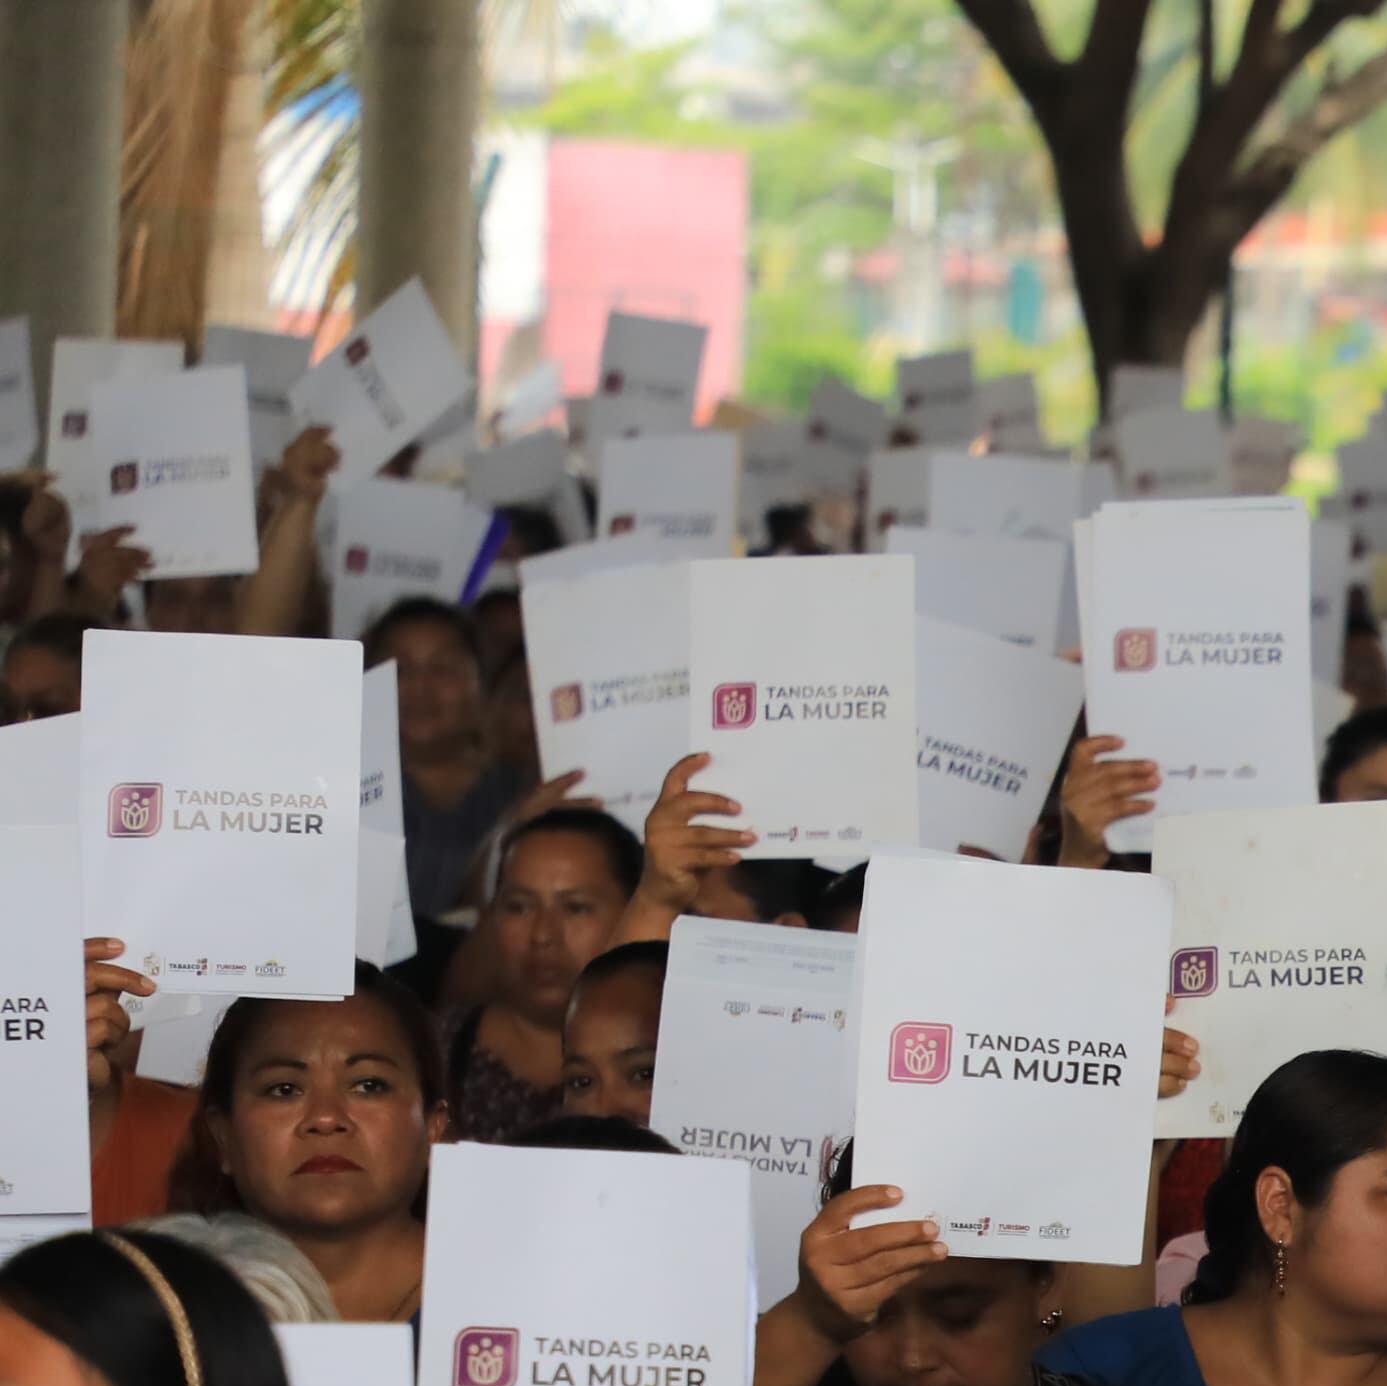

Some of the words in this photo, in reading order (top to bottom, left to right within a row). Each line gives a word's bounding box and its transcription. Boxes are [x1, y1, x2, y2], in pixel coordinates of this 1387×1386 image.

[1168, 632, 1234, 645] TANDAS
[1240, 632, 1284, 645] PARA
[1165, 648, 1195, 665] LA
[1201, 647, 1283, 665] MUJER
[766, 685, 838, 698] TANDAS
[843, 685, 890, 698] PARA
[764, 702, 795, 720] LA
[803, 701, 887, 720] MUJER
[925, 735, 983, 763] TANDAS
[987, 750, 1029, 779] PARA
[917, 751, 942, 772] LA
[946, 759, 1022, 796] MUJER
[175, 790, 262, 807] TANDAS
[270, 792, 328, 809] PARA
[173, 810, 210, 831] LA
[221, 811, 324, 834] MUJER
[1229, 949, 1309, 965] TANDAS
[1314, 948, 1367, 962] PARA
[1228, 969, 1262, 988] LA
[1271, 966, 1364, 987] MUJER
[0, 997, 49, 1013] ARA
[965, 1033, 1060, 1055] TANDAS
[1067, 1039, 1128, 1059] PARA
[962, 1055, 1002, 1079] LA
[1013, 1058, 1122, 1086] MUJER
[680, 1126, 772, 1154] MUJER
[780, 1137, 812, 1157] LA
[740, 1154, 808, 1176] TAND
[535, 1337, 639, 1358] TANDAS
[647, 1341, 712, 1362] PARA
[531, 1361, 575, 1386] LA
